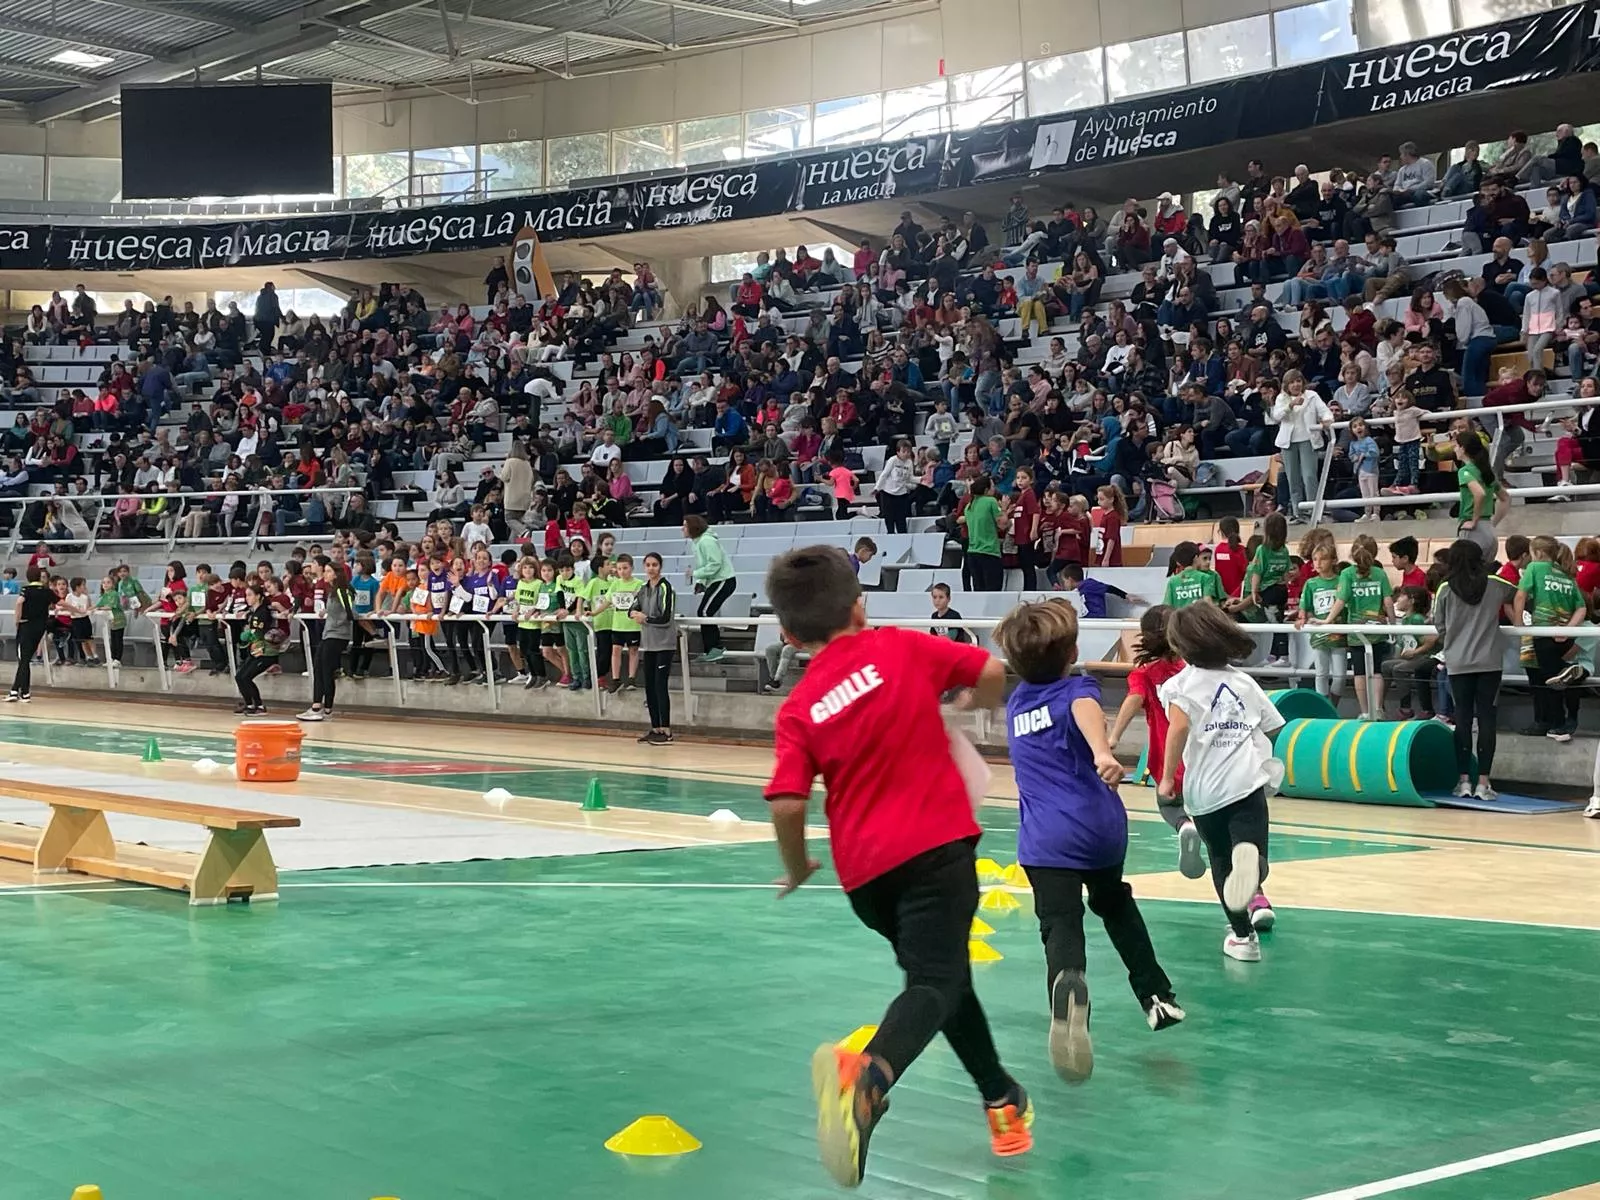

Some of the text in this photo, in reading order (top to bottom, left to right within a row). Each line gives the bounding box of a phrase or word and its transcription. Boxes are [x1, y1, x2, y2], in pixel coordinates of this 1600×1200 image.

[1344, 31, 1511, 90] Huesca
[1080, 97, 1217, 139] Ayuntamiento
[1074, 130, 1177, 162] de Huesca
[806, 145, 926, 186] Huesca
[68, 235, 192, 260] Huesca
[365, 215, 475, 247] Huesca
[810, 664, 884, 724] GUILLE
[1013, 705, 1053, 738] LUCA
